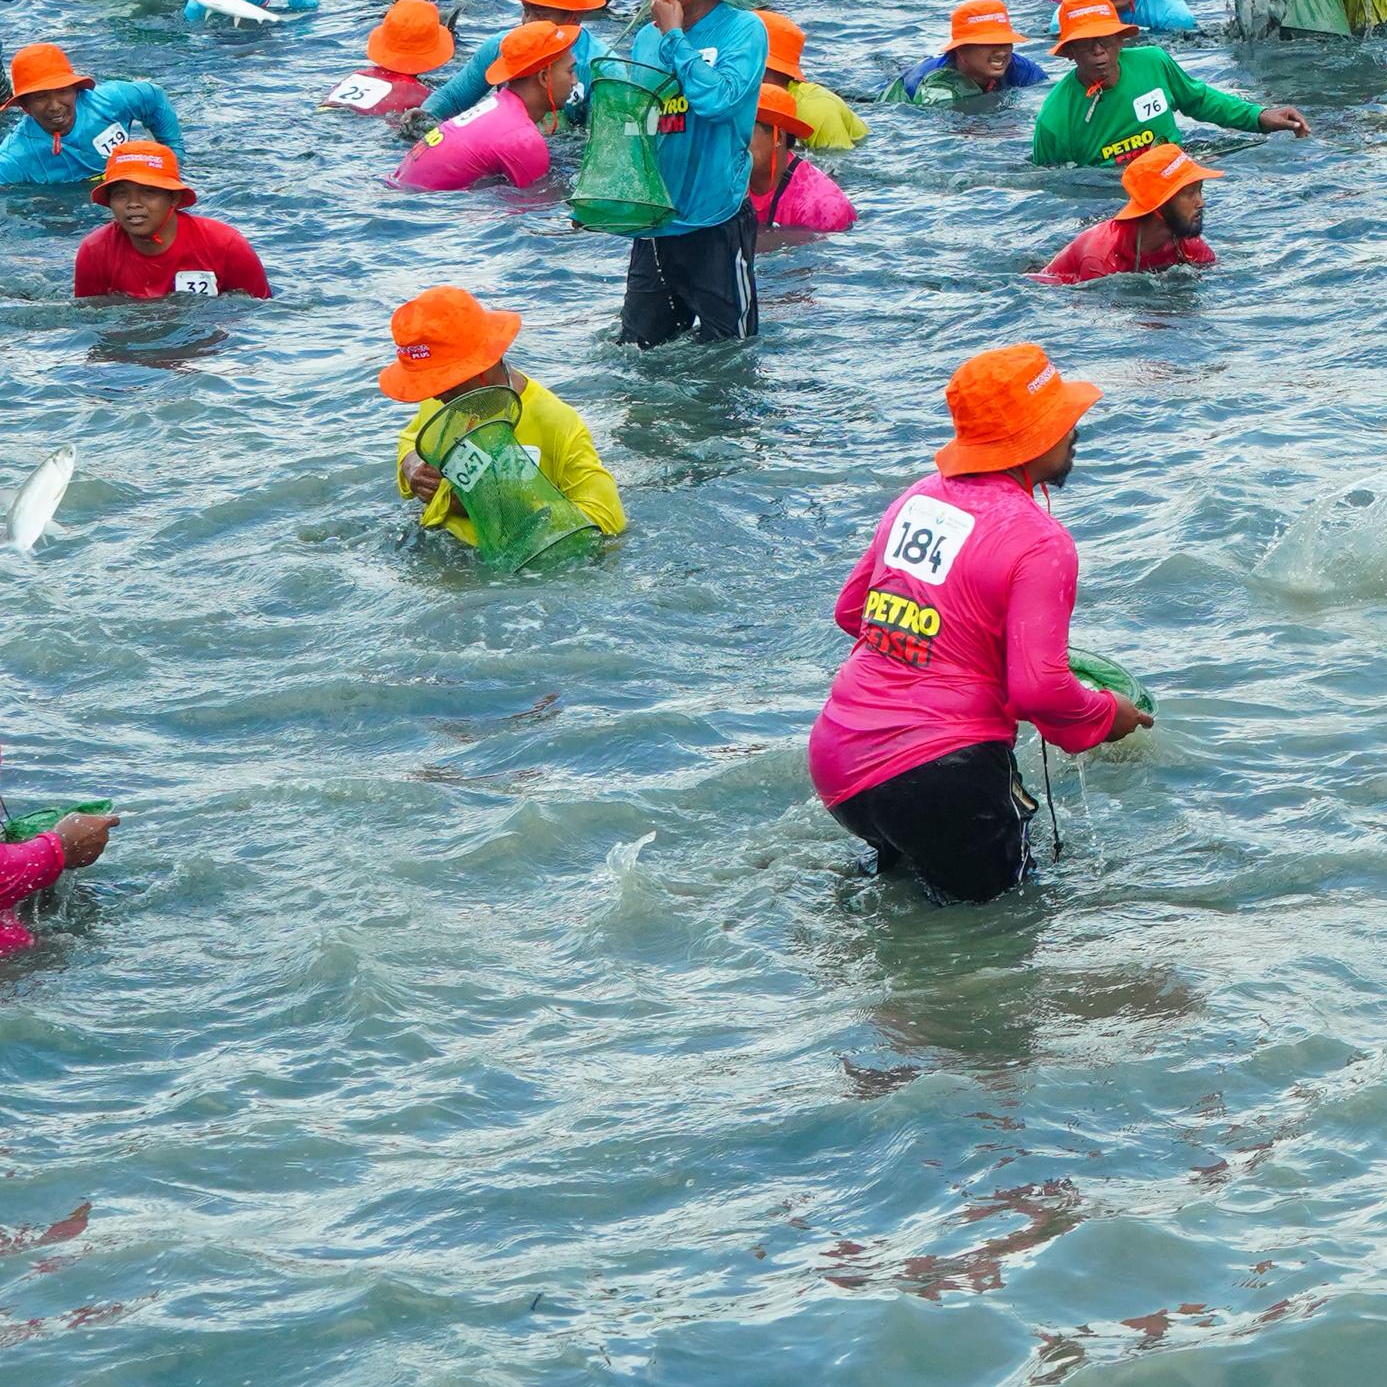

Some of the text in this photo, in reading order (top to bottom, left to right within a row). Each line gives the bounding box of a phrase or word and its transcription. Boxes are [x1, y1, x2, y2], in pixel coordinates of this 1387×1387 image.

[339, 85, 372, 102] 25
[1143, 99, 1163, 117] 76
[1101, 129, 1155, 160] PETRO
[186, 281, 211, 295] 32
[456, 450, 486, 487] 047
[892, 521, 948, 575] 184
[863, 589, 942, 638] PETRO
[864, 625, 933, 668] FISH
